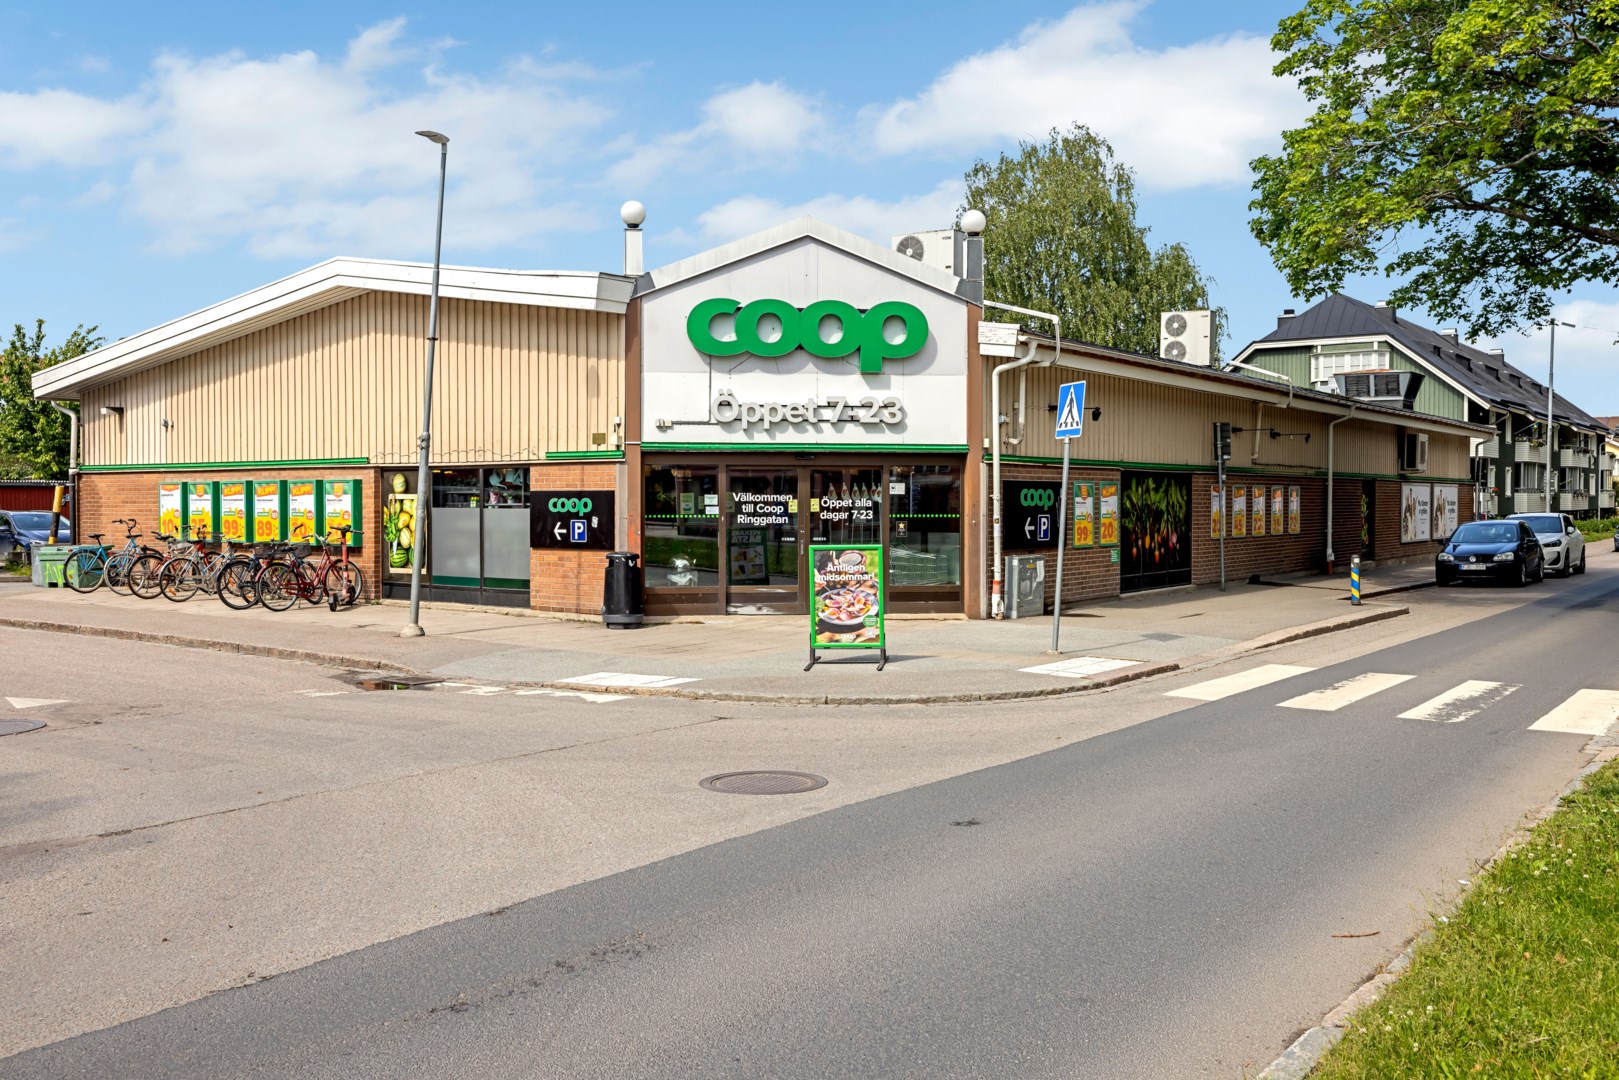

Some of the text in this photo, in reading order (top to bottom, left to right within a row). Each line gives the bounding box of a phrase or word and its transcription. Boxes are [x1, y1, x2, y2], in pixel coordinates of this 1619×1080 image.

[686, 298, 929, 373] coop
[711, 388, 902, 429] Öppet 7-23
[732, 492, 793, 502] Välkommen
[821, 496, 873, 509] Öppet alla
[1020, 489, 1054, 510] coop
[548, 497, 592, 516] coop
[741, 503, 784, 515] till Coop
[737, 514, 789, 526] Ringgatan
[820, 510, 873, 521] dagar 7-23
[162, 518, 175, 535] 10
[223, 519, 239, 536] 99
[256, 520, 273, 537] 89
[574, 522, 584, 540] P
[1040, 517, 1048, 538] P
[1076, 525, 1088, 542] 99
[1101, 521, 1113, 539] 20
[818, 572, 875, 581] midsommar!
[827, 562, 866, 575] Äntligen
